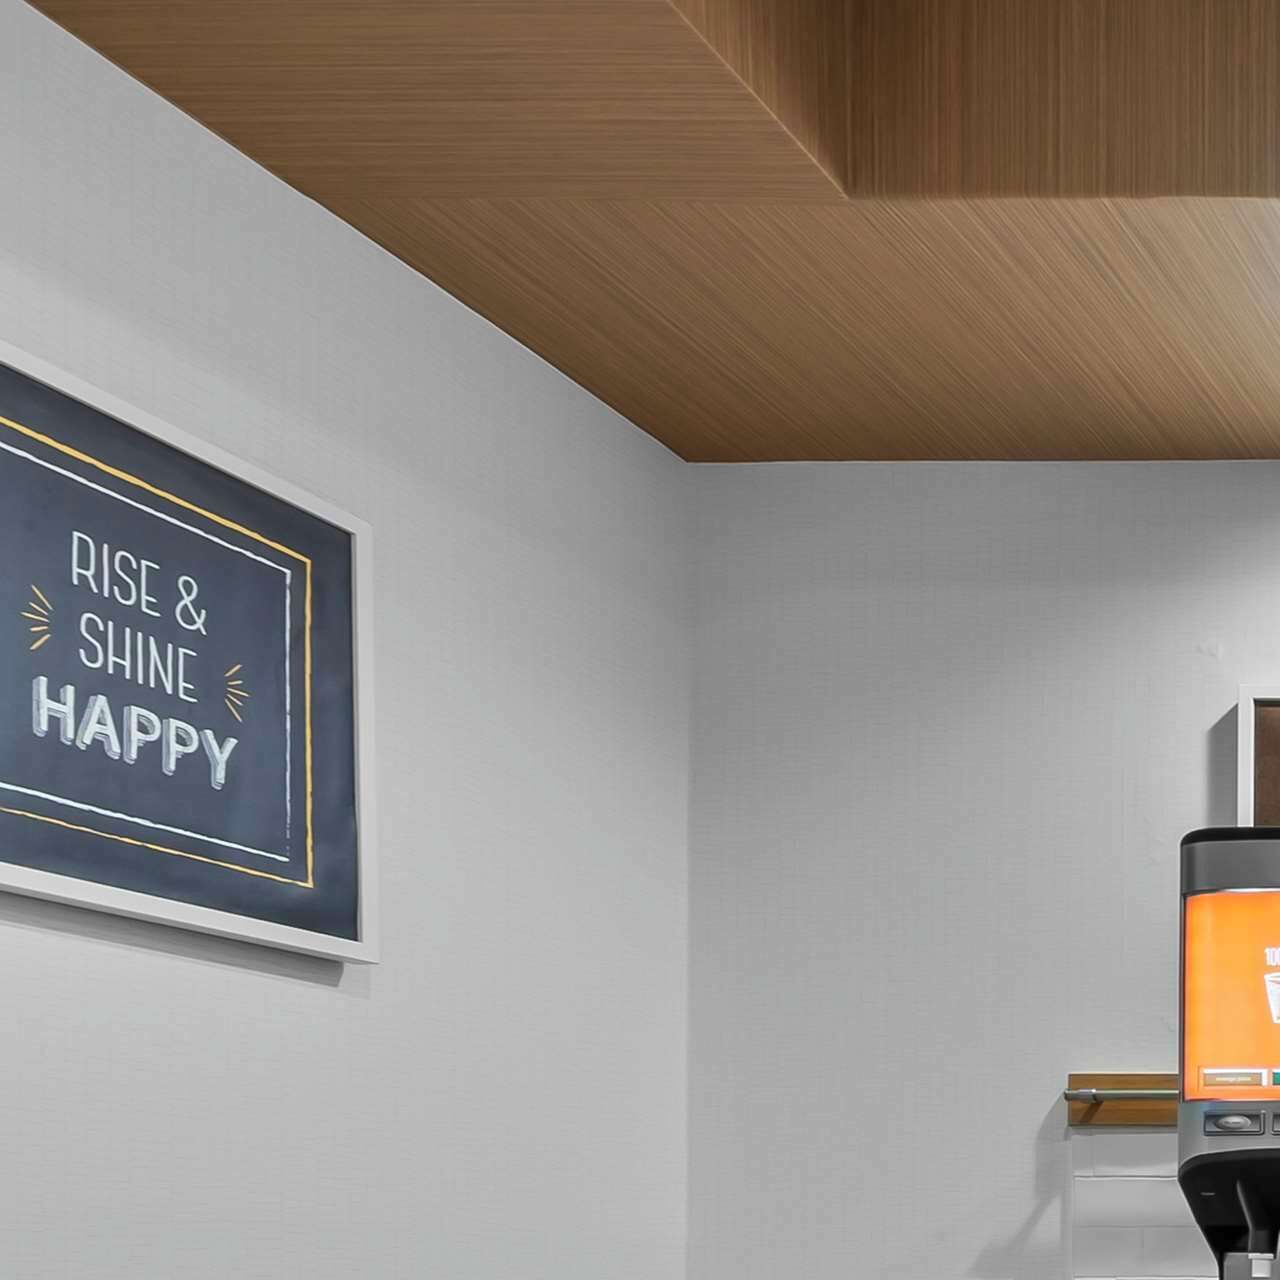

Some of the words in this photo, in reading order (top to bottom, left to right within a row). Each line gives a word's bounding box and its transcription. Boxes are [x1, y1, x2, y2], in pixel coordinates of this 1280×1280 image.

[71, 530, 161, 618] RISE
[174, 575, 208, 636] &
[78, 612, 200, 704] SHINE
[31, 675, 239, 792] HAPPY
